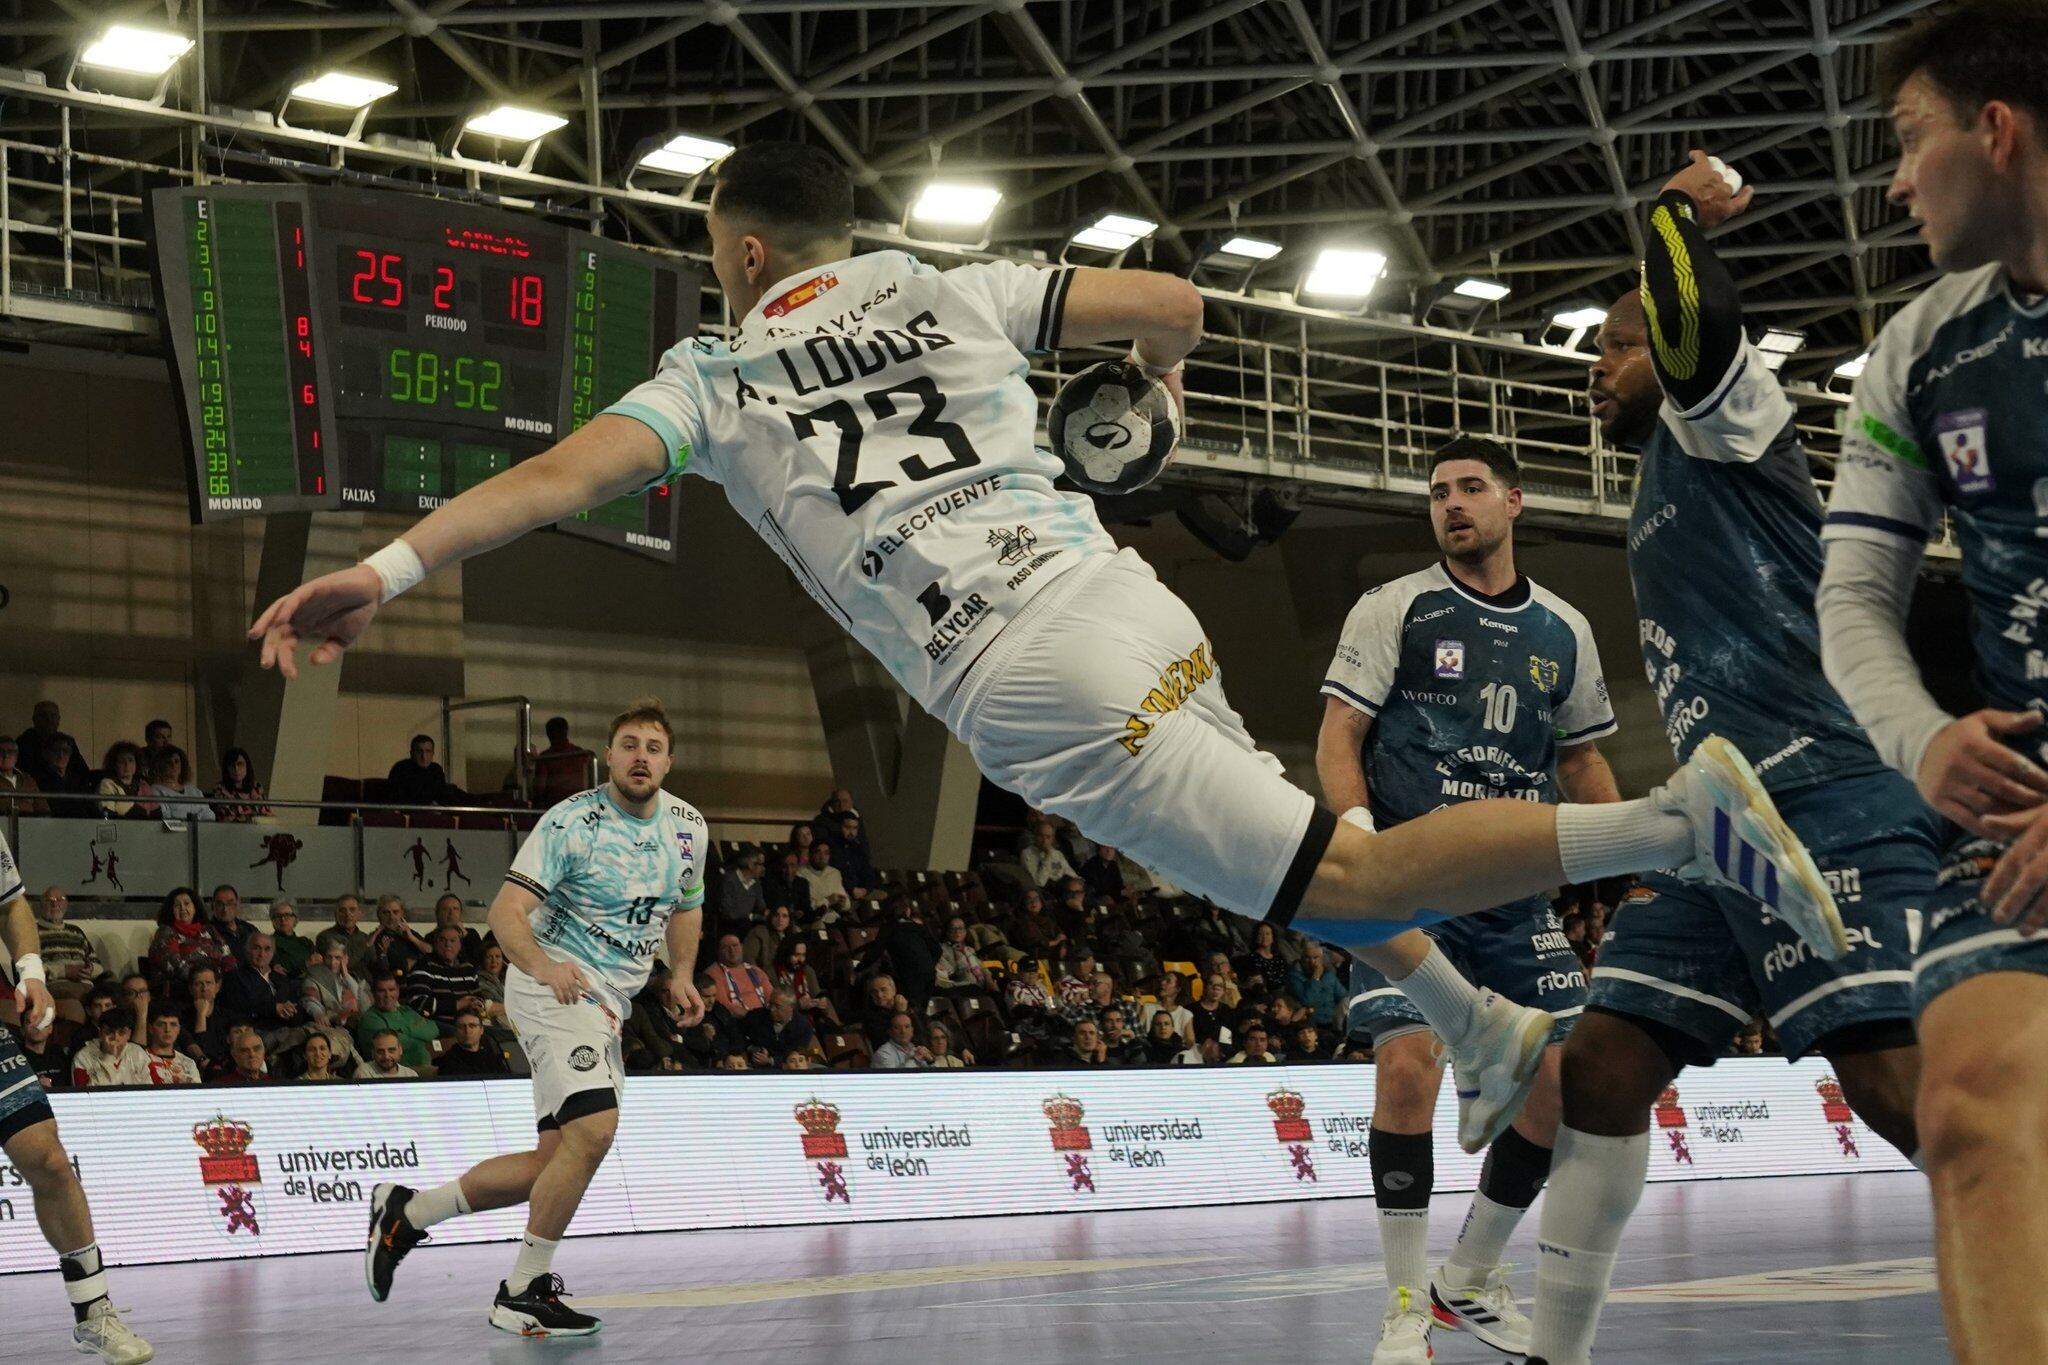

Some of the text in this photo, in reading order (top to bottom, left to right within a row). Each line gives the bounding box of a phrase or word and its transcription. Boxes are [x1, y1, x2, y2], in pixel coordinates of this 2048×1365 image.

[198, 200, 208, 219] E
[197, 222, 301, 245] 2 1
[200, 245, 303, 268] 3 1
[587, 252, 597, 270] E
[203, 268, 212, 286] 7
[352, 249, 402, 307] 25
[585, 272, 595, 290] 9
[434, 267, 454, 309] 2
[203, 291, 213, 310] 9
[510, 275, 543, 326] 18
[576, 292, 594, 311] 10
[195, 314, 309, 336] 10 8
[425, 313, 468, 334] PERIODO
[197, 336, 311, 358] 14 4
[574, 333, 593, 352] 14
[199, 359, 220, 379] 17
[389, 348, 501, 411] 58:52
[201, 382, 315, 405] 19 6
[573, 375, 592, 395] 19
[203, 406, 224, 426] 23
[504, 416, 553, 435] MONDO
[206, 429, 319, 448] 24 1
[786, 375, 982, 517] 23
[208, 452, 228, 472] 33
[210, 476, 322, 495] 66 1
[342, 487, 376, 504] FALTAS
[208, 497, 262, 511] MONDO
[878, 475, 1001, 556] ELECPUENTE
[626, 531, 671, 552] MONDO
[1006, 567, 1032, 591] PASO
[924, 592, 989, 661] BELYCAR
[1479, 617, 1519, 634] Kempa
[1401, 689, 1457, 706] WOFCO
[1479, 682, 1518, 734] 10
[670, 805, 704, 827] alsa
[627, 896, 661, 925] 13
[1694, 1099, 1769, 1120] universidad
[1102, 1117, 1203, 1142] universidad
[1322, 1112, 1371, 1133] univer
[1712, 1122, 1744, 1142] león
[861, 1122, 972, 1150] universidad
[1343, 1135, 1370, 1158] leó
[278, 1139, 419, 1173] universidad
[866, 1152, 930, 1177] de león
[1109, 1143, 1166, 1168] de león
[284, 1174, 363, 1203] de león
